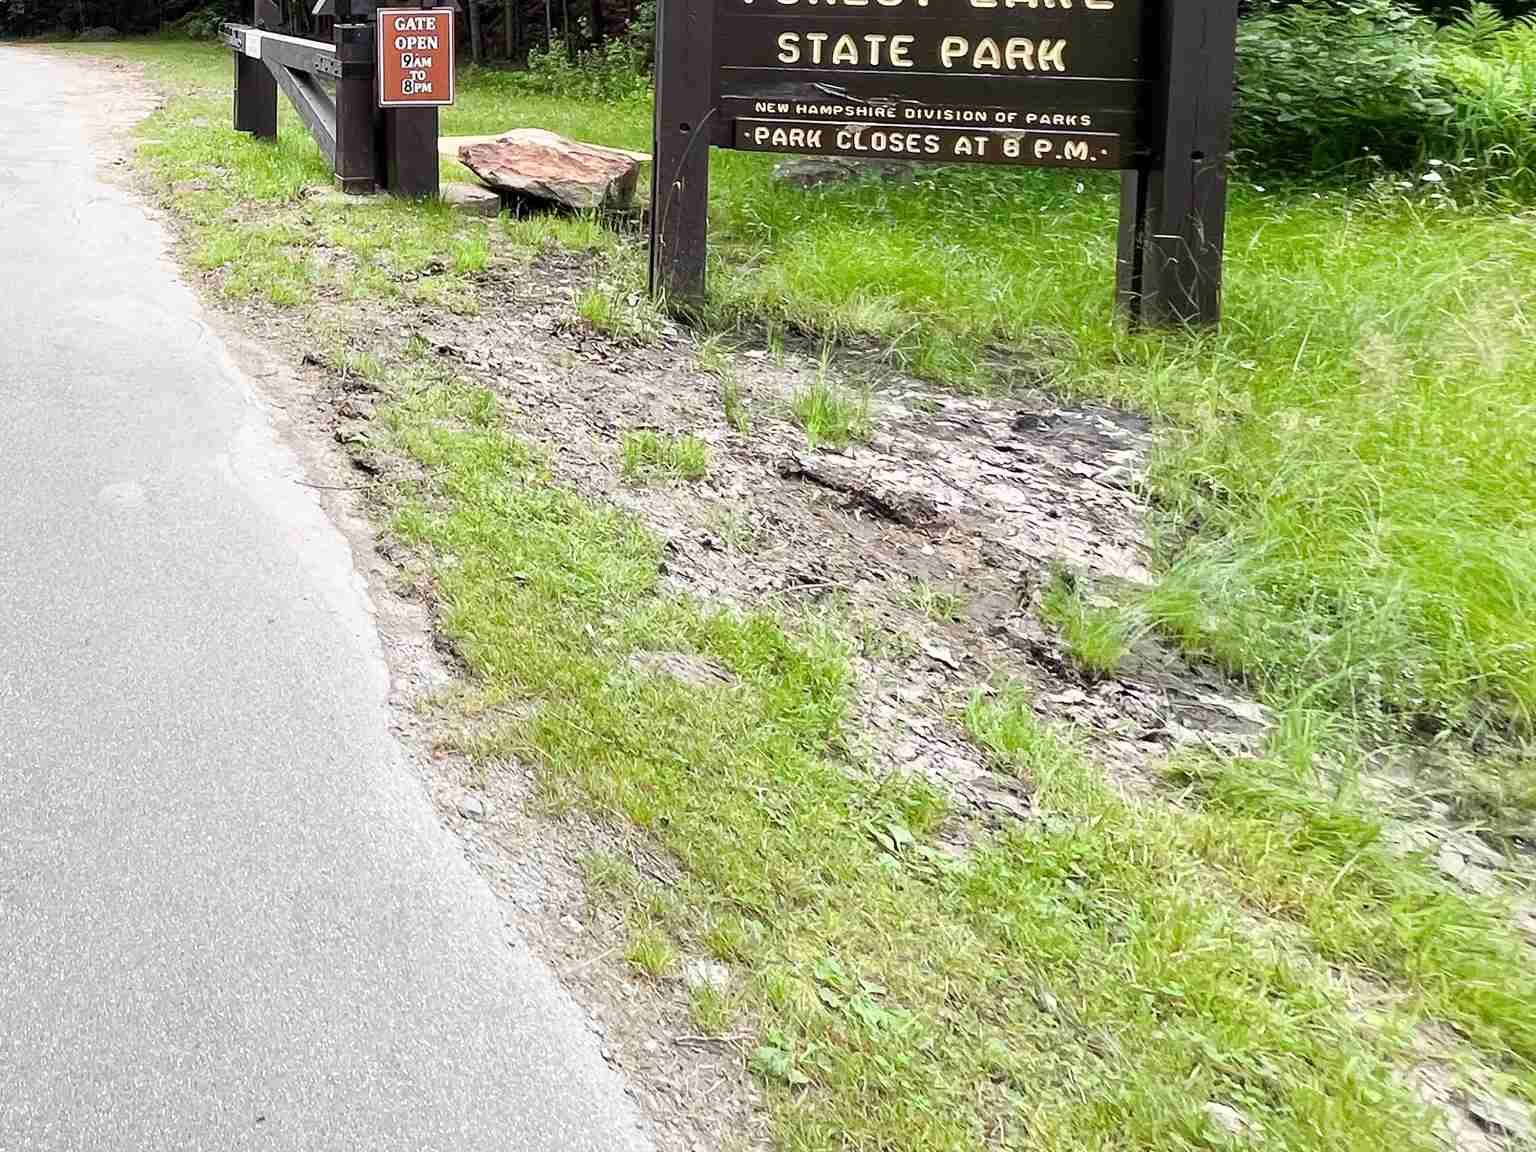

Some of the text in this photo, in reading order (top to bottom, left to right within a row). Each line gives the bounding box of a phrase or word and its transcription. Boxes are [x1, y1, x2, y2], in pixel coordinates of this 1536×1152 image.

[394, 17, 436, 31] GATE
[394, 36, 438, 49] OPEN
[777, 32, 1066, 72] STATE PARK
[409, 70, 426, 81] TO
[755, 102, 1091, 126] NEW HAMPSHIRE DIVISION OF PARKS
[754, 126, 822, 149] PARK
[836, 128, 940, 154] CLOSES
[954, 136, 989, 156] AT
